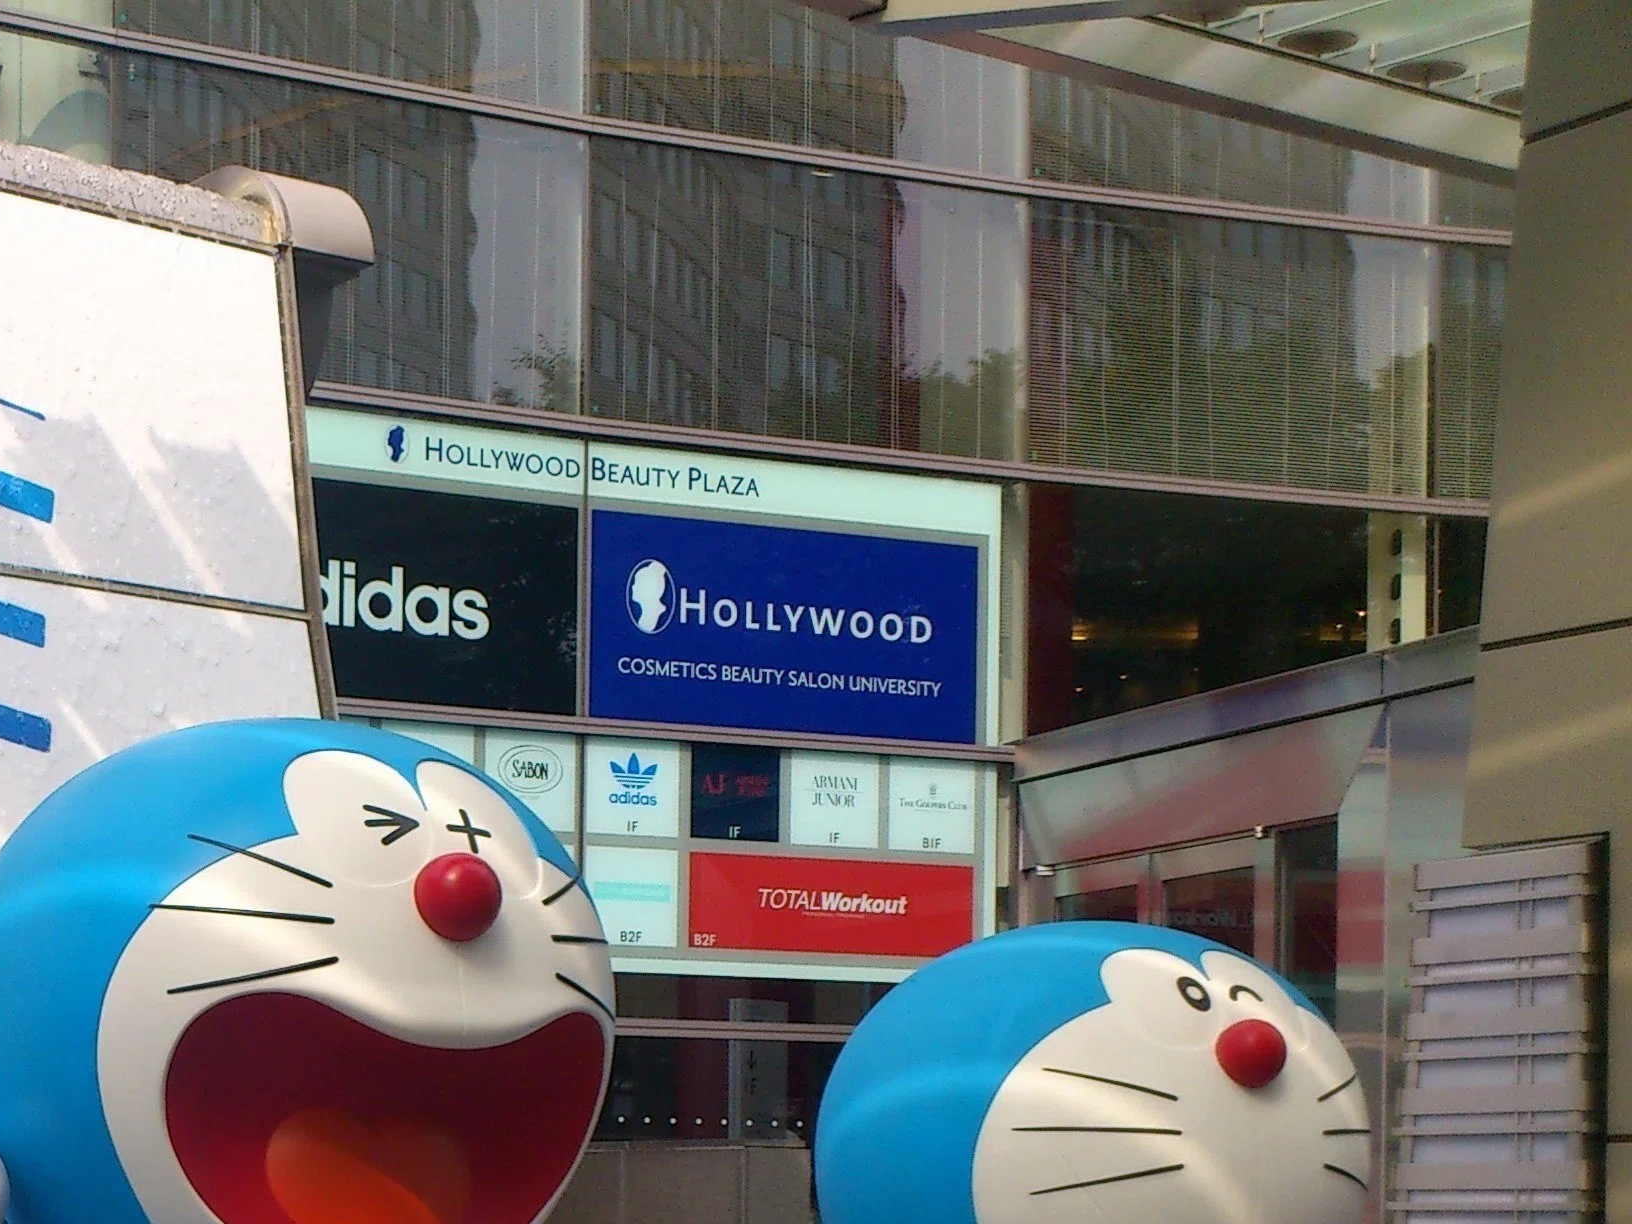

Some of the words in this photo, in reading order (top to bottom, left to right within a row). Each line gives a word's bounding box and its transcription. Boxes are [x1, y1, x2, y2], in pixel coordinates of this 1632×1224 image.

[425, 437, 580, 479] HOLLYWOOD
[591, 457, 680, 489] BEAUTY
[687, 467, 760, 498] PLAZA
[679, 587, 933, 644] HOLLYWOOD
[617, 656, 717, 680] COSMETICS
[721, 665, 784, 687] BEAUTY
[787, 670, 845, 690] SALON
[848, 676, 942, 698] UNIVERSITY
[512, 759, 549, 780] SABON
[812, 775, 858, 791] ARMANI
[608, 791, 658, 806] adidas
[811, 792, 856, 808] JUNIOR
[620, 930, 643, 943] B2F
[693, 933, 717, 946] B2F
